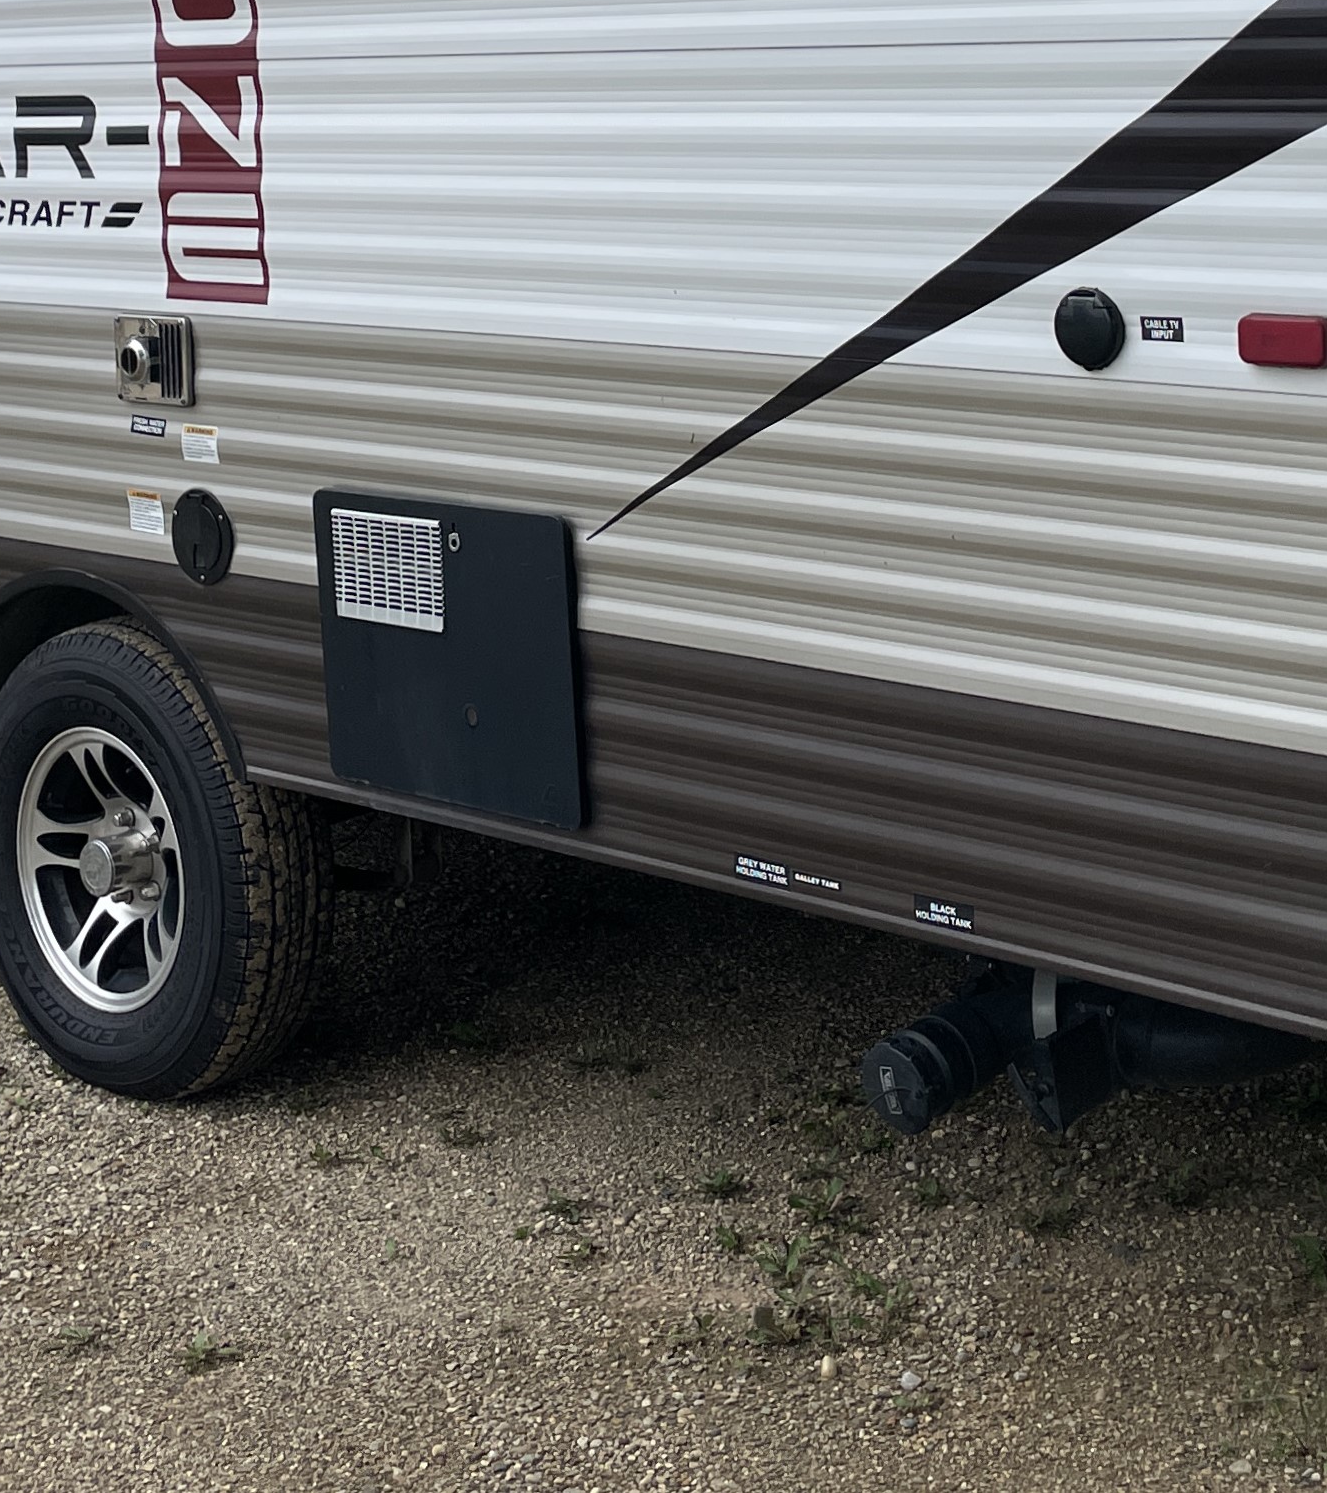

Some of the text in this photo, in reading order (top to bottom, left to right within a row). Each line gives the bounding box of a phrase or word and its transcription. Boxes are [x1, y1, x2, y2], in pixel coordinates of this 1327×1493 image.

[1144, 318, 1179, 330] CABLE TV
[1150, 329, 1174, 340] INPUT
[737, 856, 786, 876] GREY WATER
[735, 865, 789, 886] HOLDING TANK
[794, 873, 840, 891] GALLEY TANK
[930, 902, 957, 917] BLACK
[915, 909, 972, 930] HOLDING TANK
